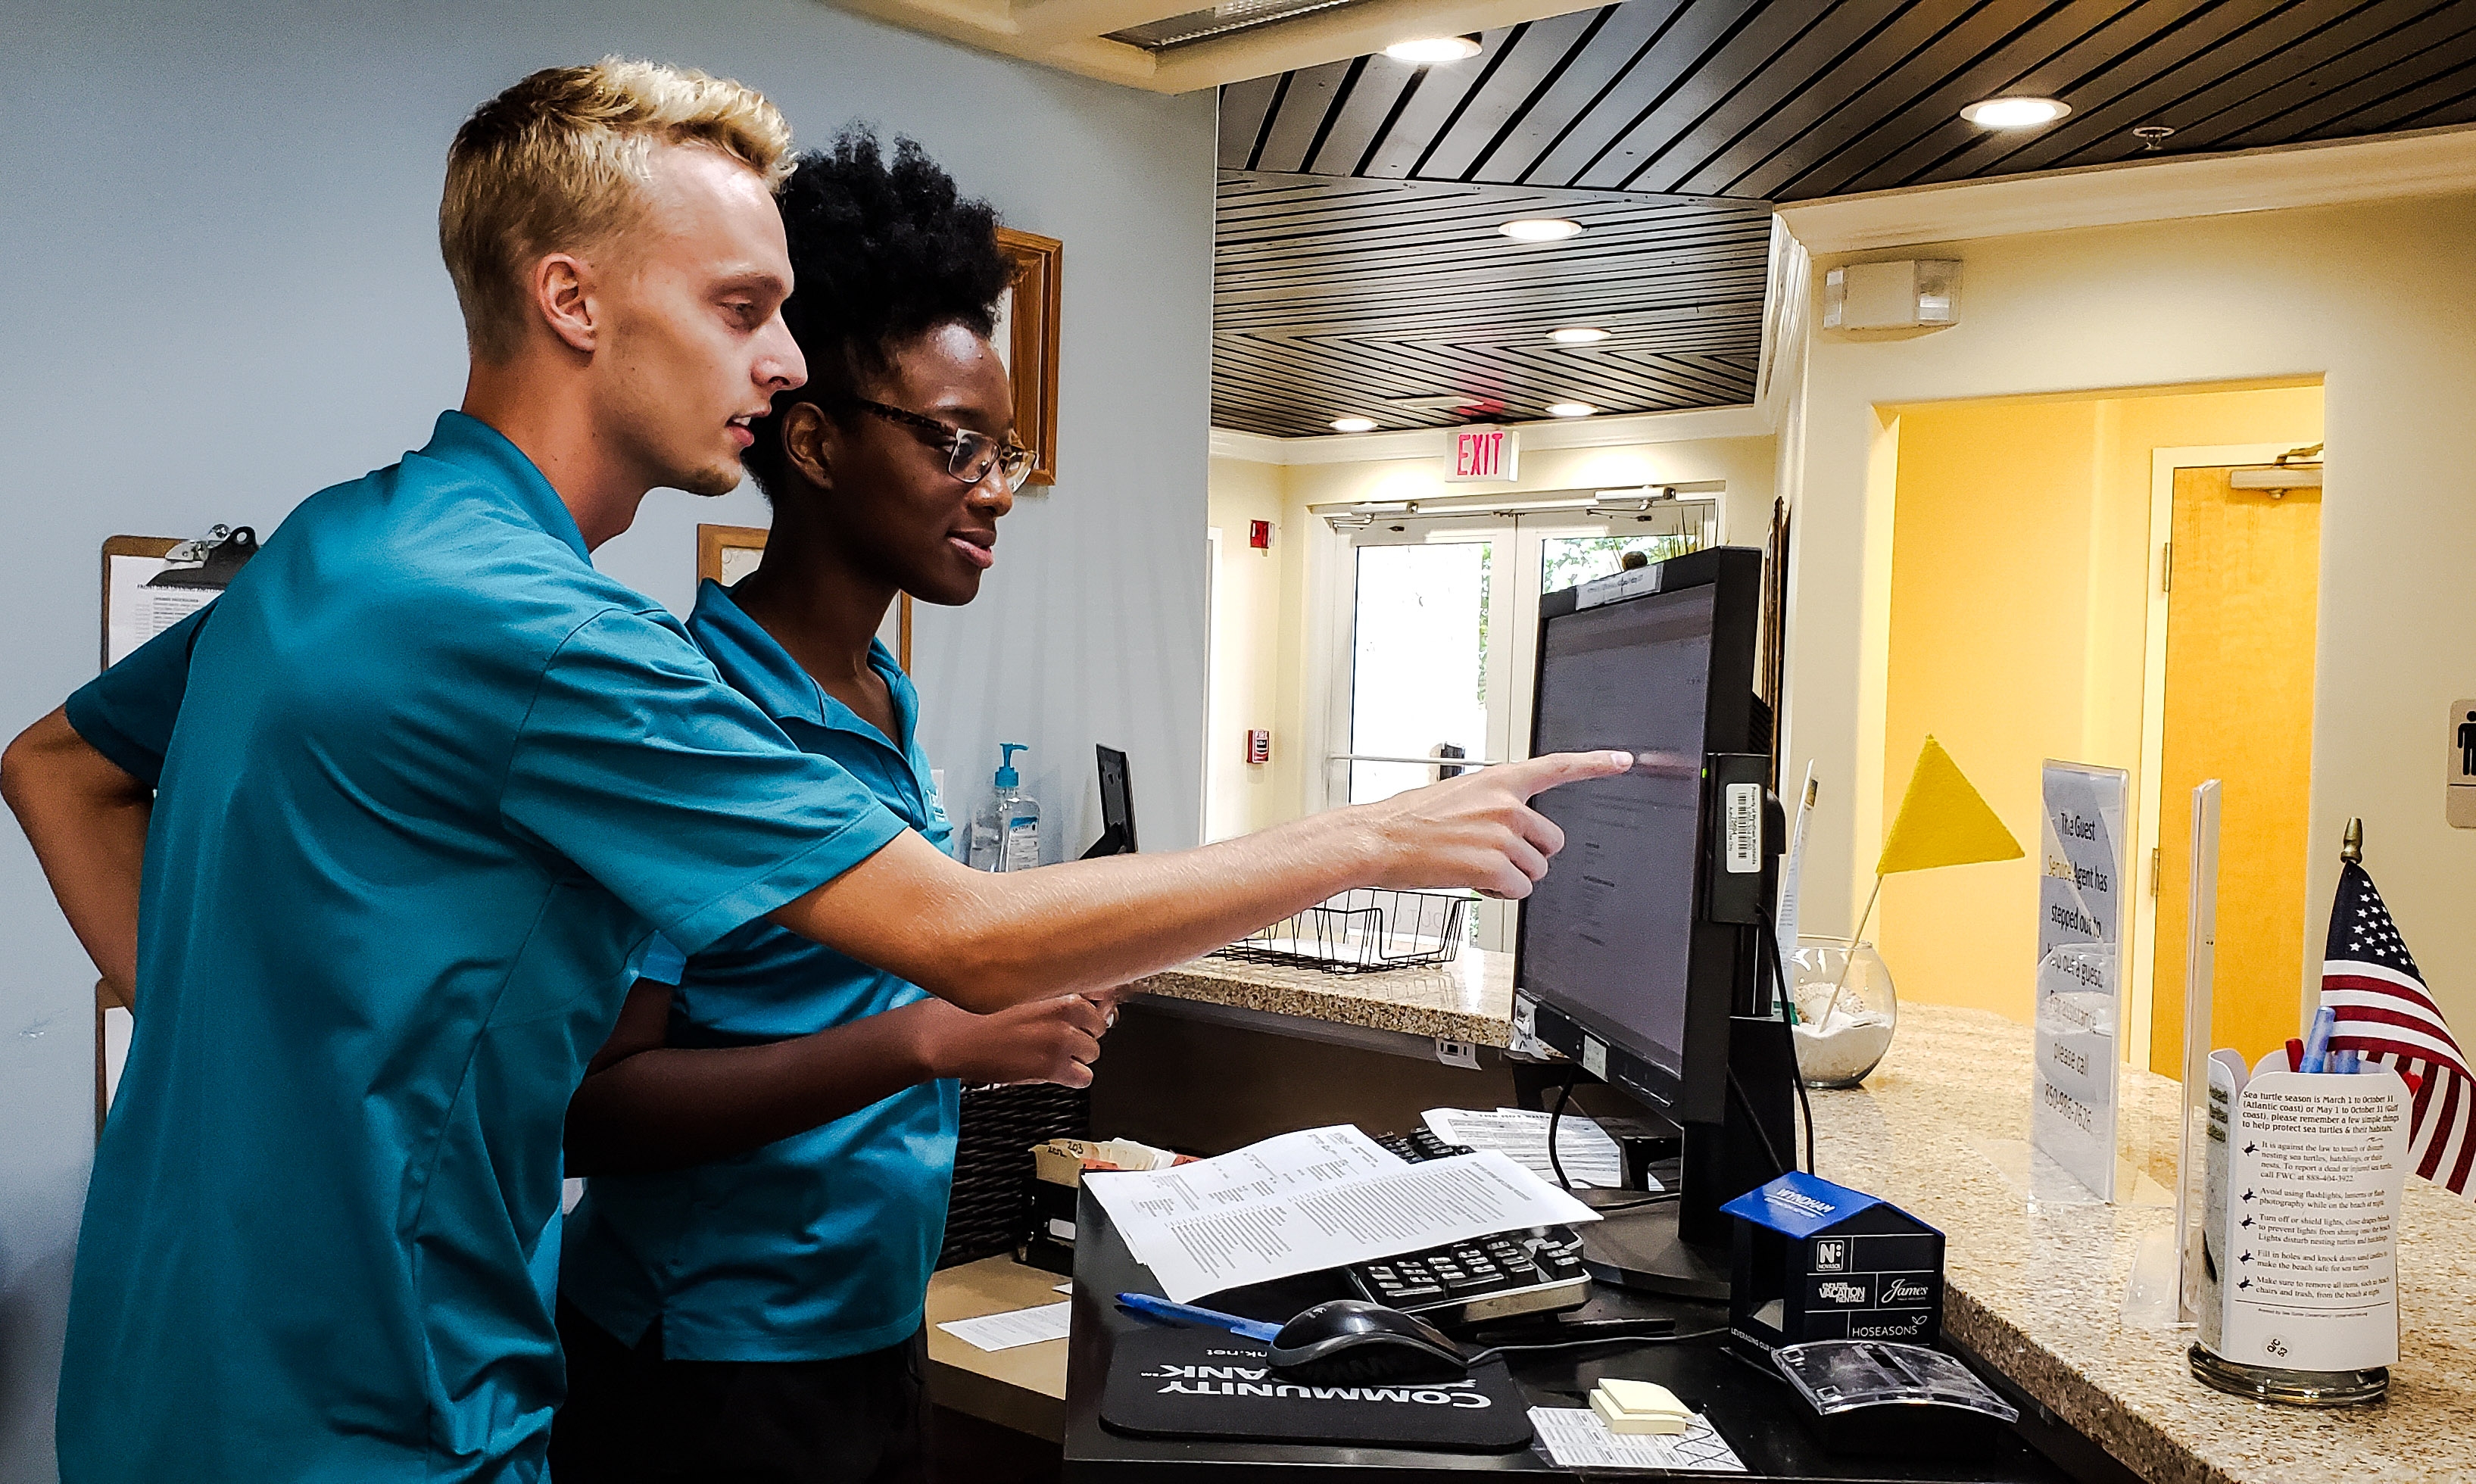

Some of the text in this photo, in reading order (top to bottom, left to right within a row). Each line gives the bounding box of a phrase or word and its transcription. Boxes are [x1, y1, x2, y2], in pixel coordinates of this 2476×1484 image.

[1457, 432, 1505, 477] EXIT
[2061, 812, 2095, 841] The Guest
[2074, 861, 2094, 890] Agent
[2094, 865, 2107, 893] has
[2051, 903, 2101, 939] stepped out to
[2053, 1038, 2088, 1078] please call
[2243, 1091, 2258, 1099] Sea
[2260, 1093, 2282, 1102] turtle
[2284, 1095, 2312, 1103] season
[2322, 1096, 2346, 1104] March
[2243, 1100, 2278, 1111] (Atlantic
[2279, 1105, 2303, 1113] coast)
[2316, 1106, 2333, 1115] May
[2271, 1113, 2297, 1122] please
[2300, 1115, 2340, 1124] remember
[2253, 1121, 2270, 1131] help
[2272, 1124, 2300, 1132] protect
[1068, 1140, 1084, 1155] 203
[2262, 1152, 2287, 1161] nesting
[2261, 1187, 2282, 1196] Avoid
[1776, 1189, 1836, 1213] WYNDHAM
[2259, 1198, 2304, 1208] photography
[2259, 1213, 2276, 1222] Turn
[2258, 1233, 2281, 1242] Lights
[2283, 1236, 2308, 1244] disturb
[2281, 1252, 2300, 1260] holes
[2292, 1263, 2313, 1271] beach
[2257, 1276, 2277, 1285] Make
[1819, 1286, 1866, 1298] VACATION
[1881, 1279, 1929, 1304] James
[2256, 1286, 2278, 1295] chairs
[1852, 1325, 1918, 1337] HOSEASONS
[1206, 1349, 1268, 1358] nk.net
[2278, 1347, 2287, 1358] 53
[1159, 1364, 1271, 1380] ANK
[1156, 1380, 1492, 1409] COMMUNITY
